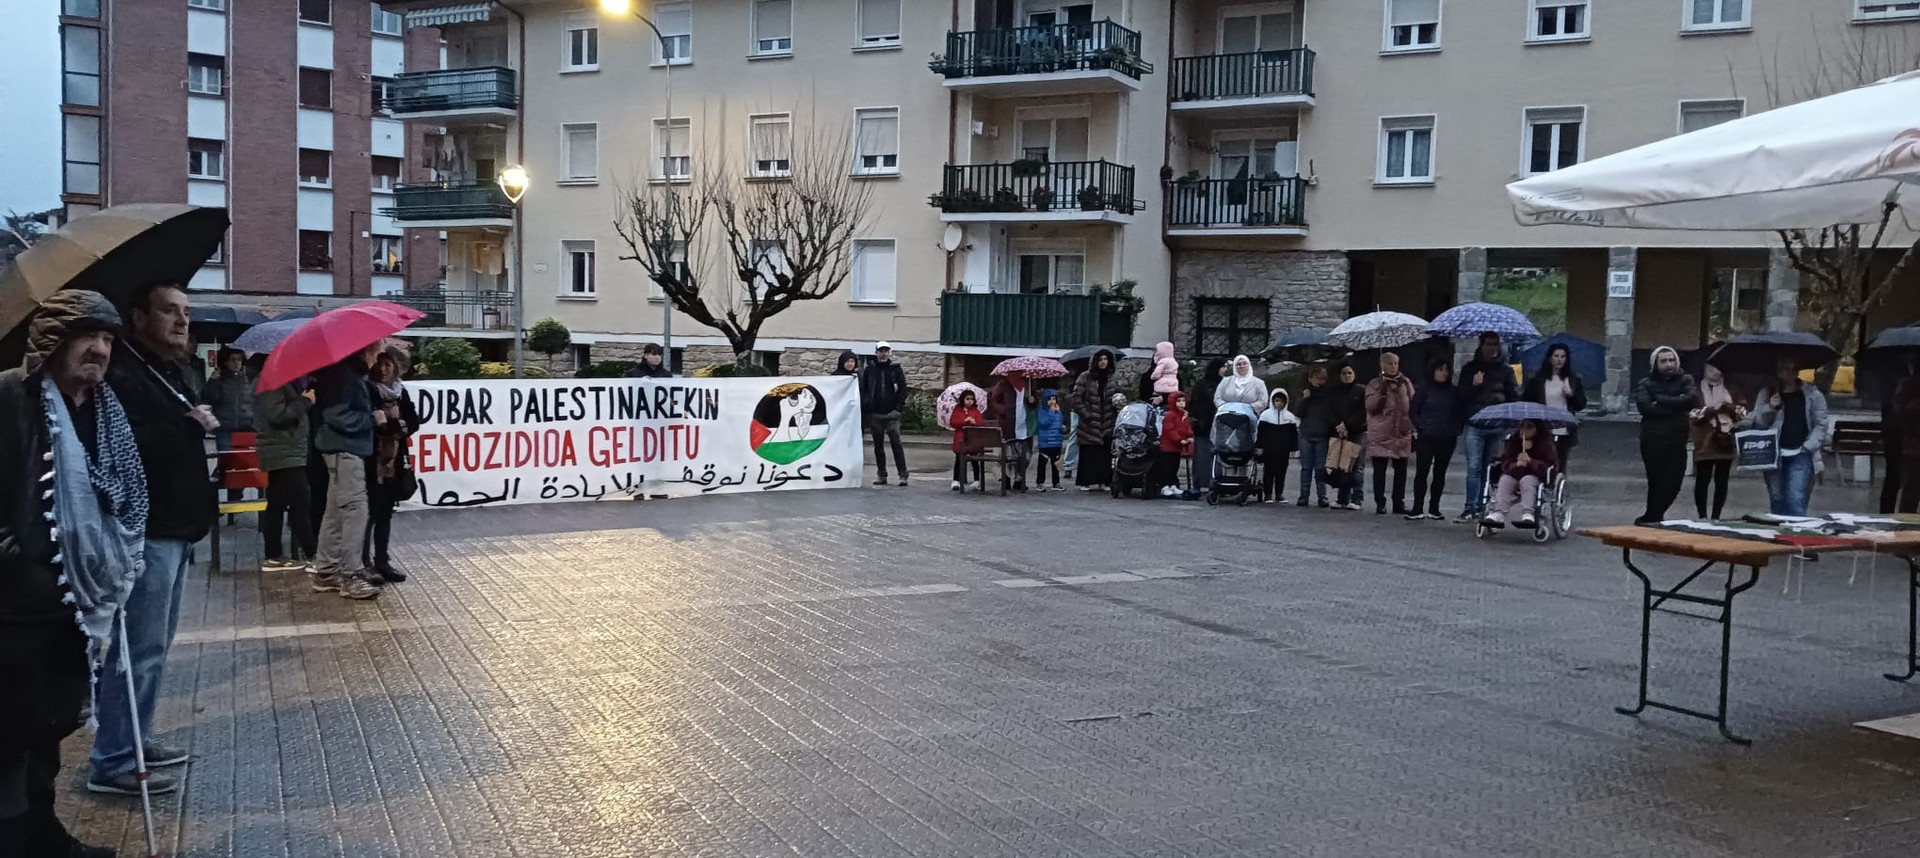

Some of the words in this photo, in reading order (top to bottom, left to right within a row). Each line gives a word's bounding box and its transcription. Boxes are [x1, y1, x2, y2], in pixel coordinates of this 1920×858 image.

[418, 388, 494, 425] DIBAR
[510, 386, 719, 425] PALESTINAREKIN
[588, 424, 700, 468] GELDITU
